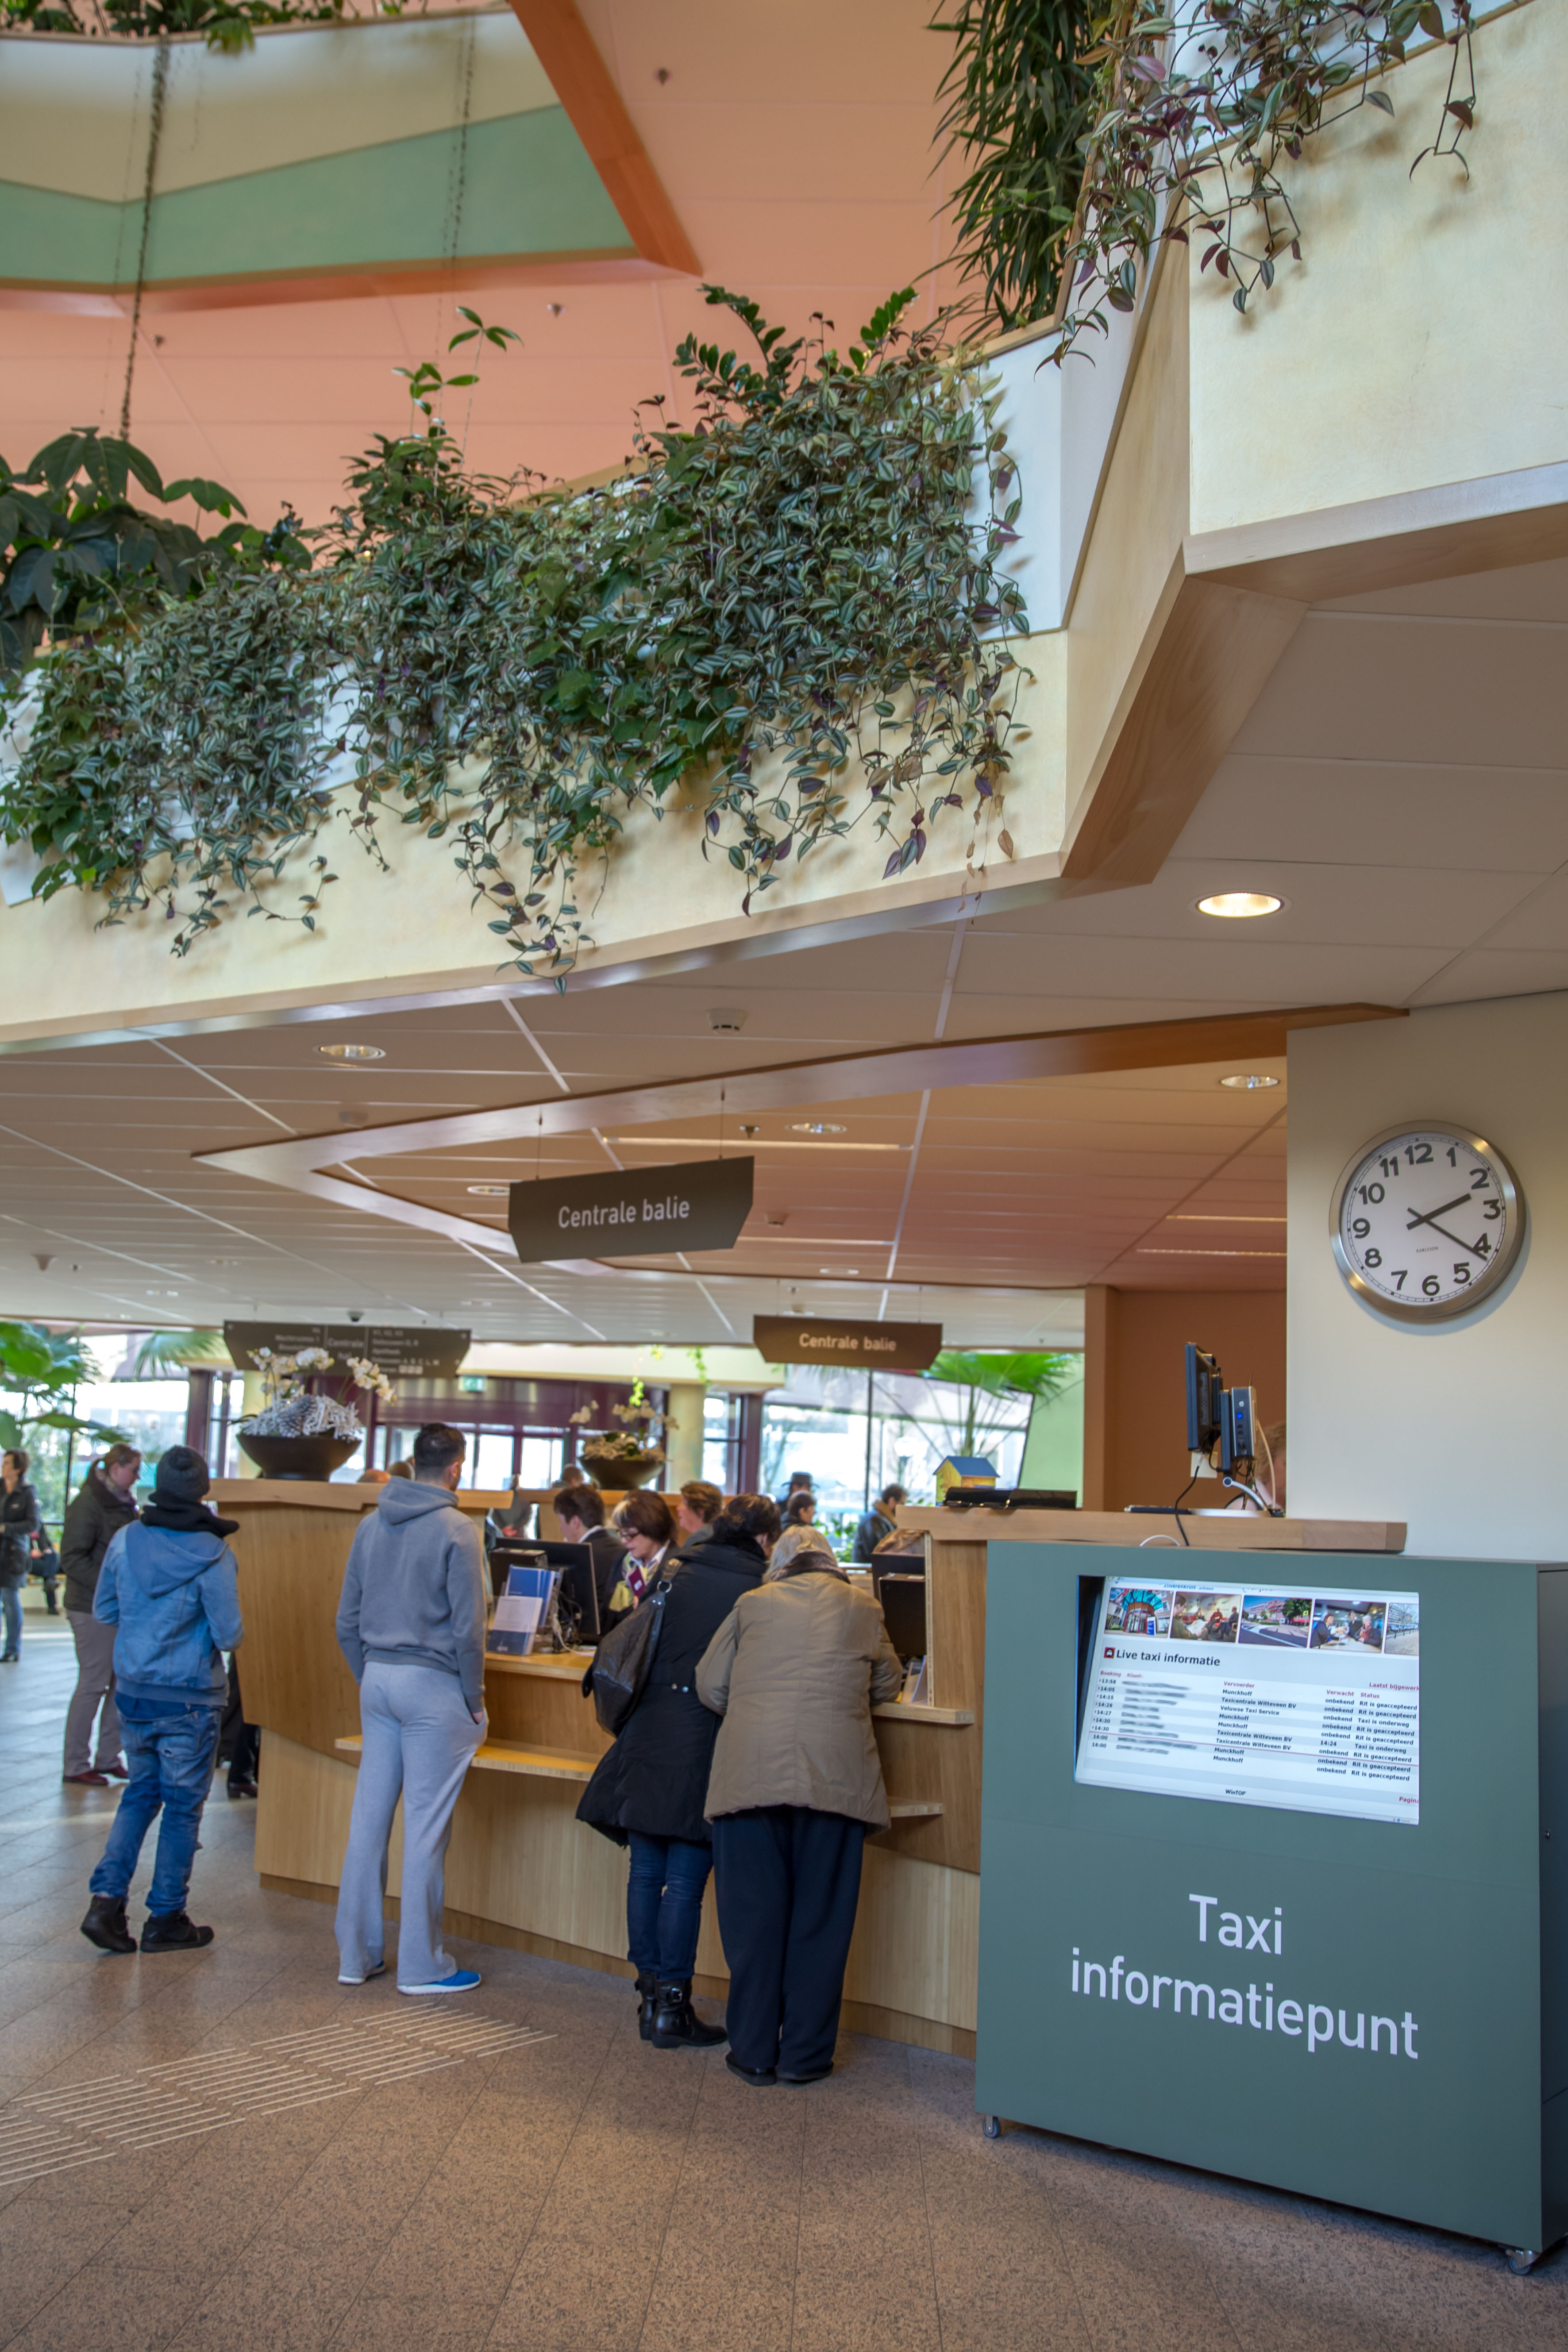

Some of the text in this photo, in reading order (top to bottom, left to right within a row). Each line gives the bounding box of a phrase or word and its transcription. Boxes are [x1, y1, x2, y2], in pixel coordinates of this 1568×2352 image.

[1404, 1143, 1433, 1165] 12
[1446, 1147, 1456, 1167] 1
[1379, 1156, 1399, 1177] 11
[1469, 1168, 1490, 1189] 2
[1358, 1183, 1385, 1205] 10
[558, 1196, 690, 1228] Centrale balie
[1483, 1199, 1501, 1220] 3
[1352, 1218, 1371, 1239] 9
[1472, 1233, 1491, 1253] 4
[1365, 1248, 1382, 1268] 8
[1391, 1270, 1408, 1290] 7
[1453, 1262, 1471, 1284] 5
[1422, 1275, 1440, 1296] 6
[799, 1333, 897, 1351] Centrale balie
[1117, 1650, 1220, 1666] Live taxi informatie
[1376, 1702, 1417, 1711] geaccepteerd
[1373, 1737, 1414, 1745] geaccepteerd
[1374, 1728, 1414, 1737] geaccepteerd
[1371, 1754, 1412, 1763] geaccepteerd
[1376, 1746, 1406, 1754] onderweg
[1369, 1772, 1410, 1781] geaccepteerd
[1370, 1764, 1410, 1772] geaccepteerd
[1189, 1894, 1282, 1955] Taxi
[1072, 1948, 1418, 2059] informatiepunt
